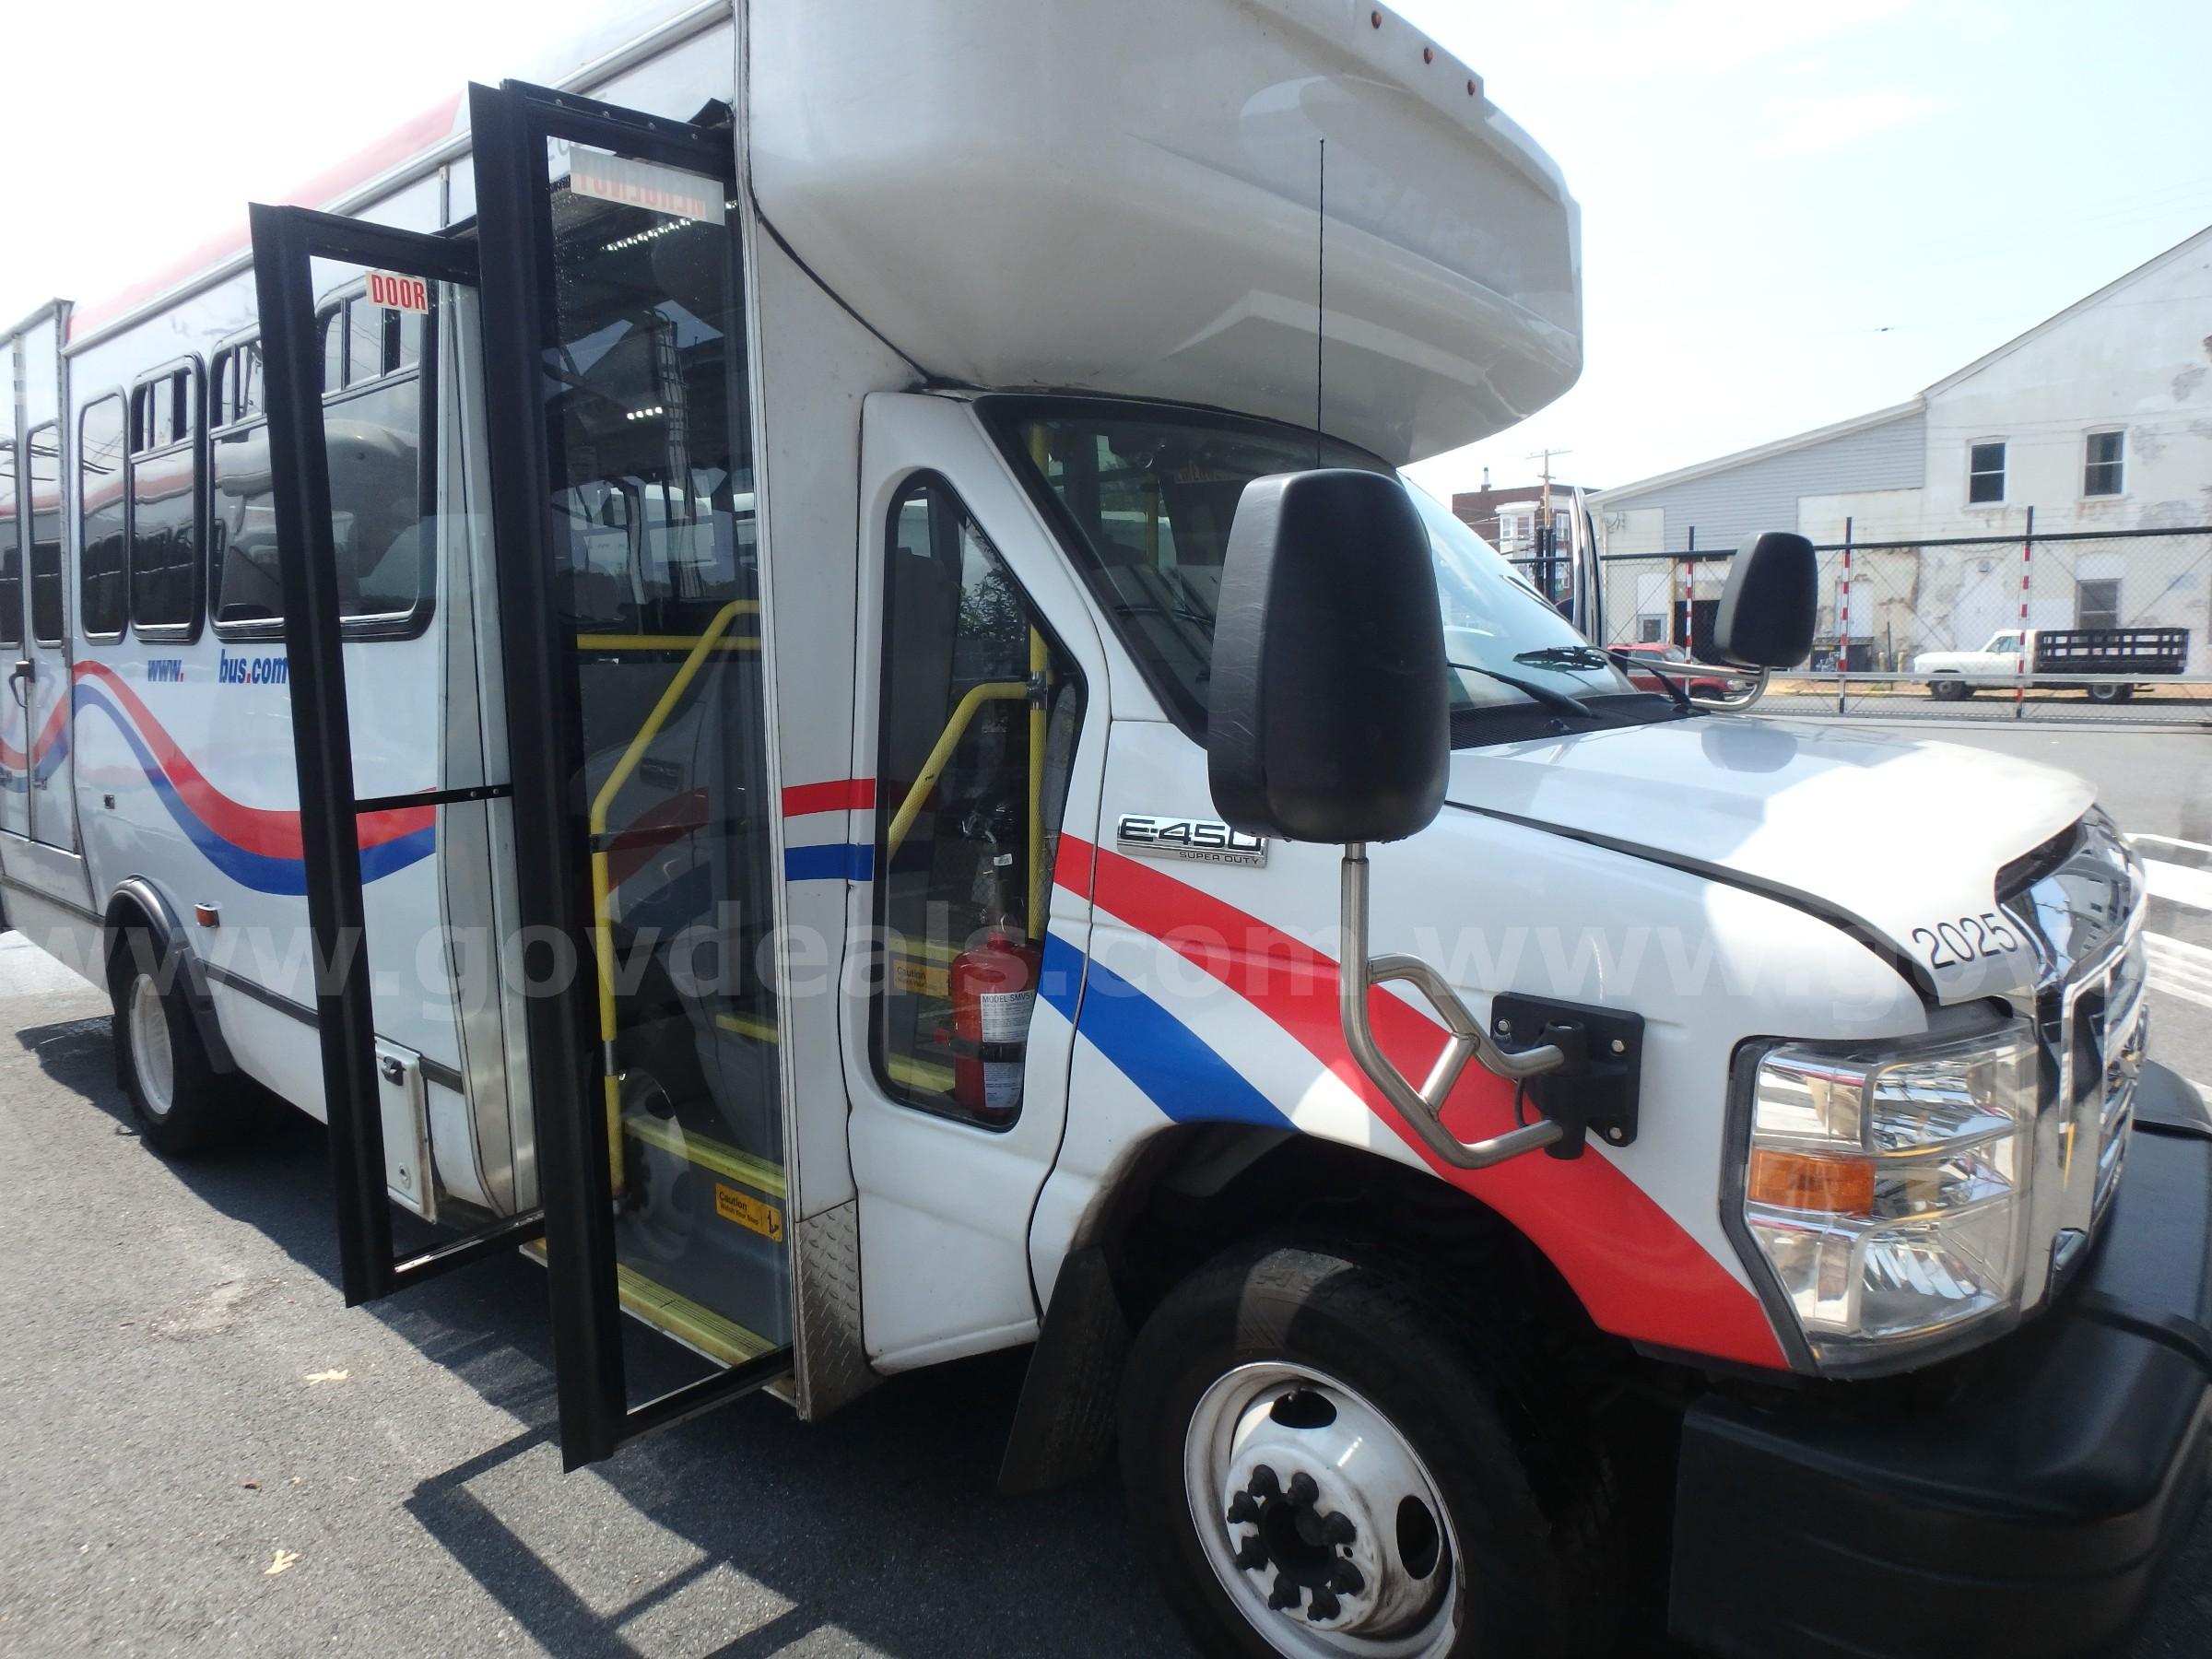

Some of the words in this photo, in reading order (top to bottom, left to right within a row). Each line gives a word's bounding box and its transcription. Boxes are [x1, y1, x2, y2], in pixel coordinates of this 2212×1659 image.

[371, 274, 426, 311] DOOR
[147, 659, 184, 683] www.
[218, 648, 288, 684] bus.com
[1179, 851, 1220, 862] SUPER
[1224, 854, 1260, 865] DUTY
[1912, 912, 2018, 970] 2025
[982, 994, 1008, 1003] MODEL
[719, 1191, 747, 1210] Caution
